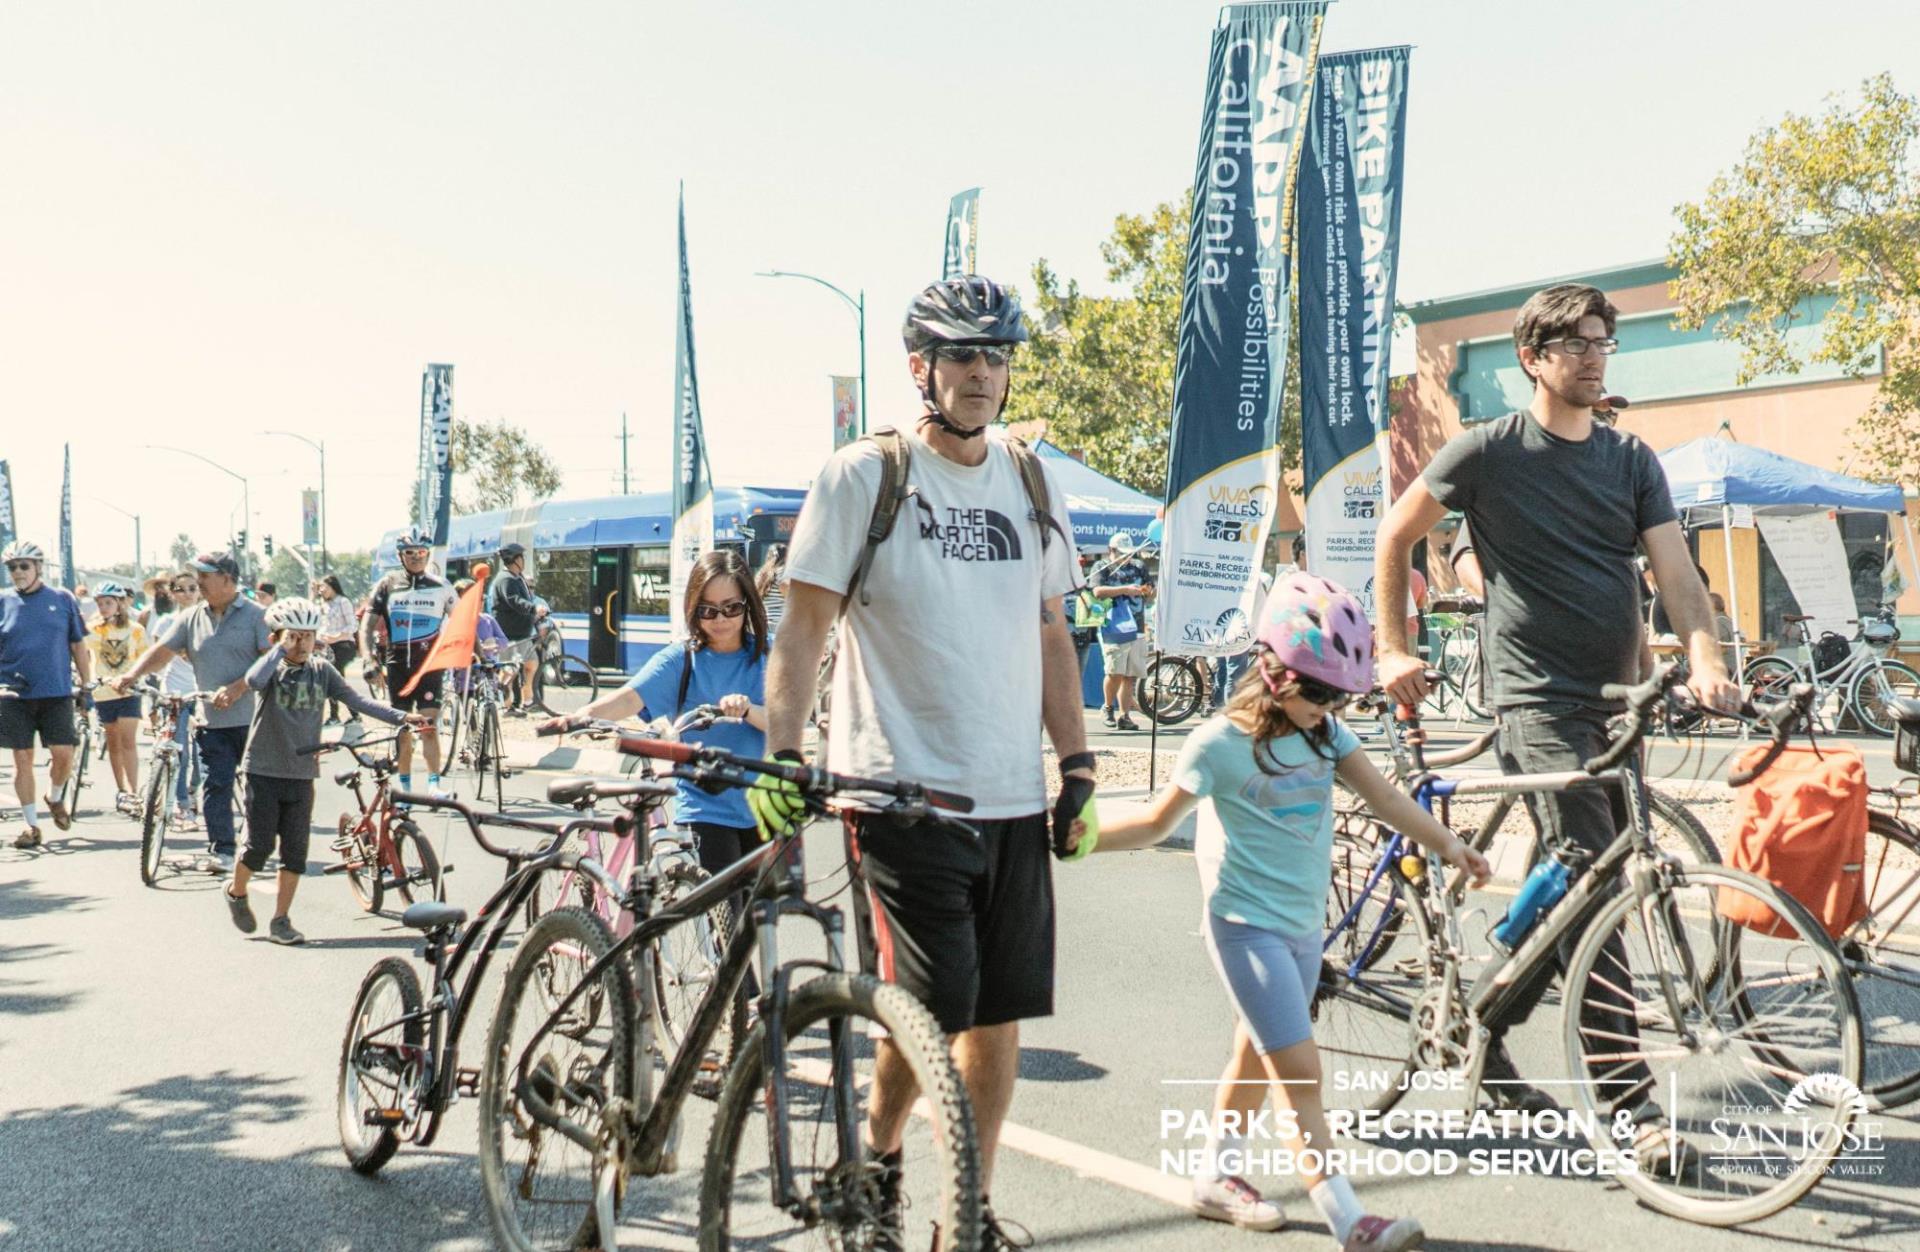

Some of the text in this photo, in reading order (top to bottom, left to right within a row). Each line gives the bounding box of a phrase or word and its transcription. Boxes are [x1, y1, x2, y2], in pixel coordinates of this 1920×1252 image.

[1323, 100, 1332, 117] not
[1356, 59, 1392, 179] BIKE
[1254, 15, 1303, 249] AARP
[1323, 118, 1332, 165] removed
[1202, 38, 1257, 286] California
[1322, 167, 1331, 196] when
[1333, 65, 1354, 427] Park at your own risk and provide your own lock.
[1325, 266, 1335, 295] ends,
[1262, 267, 1283, 328] Real
[1327, 296, 1336, 316] risk
[1326, 318, 1337, 353] having
[1328, 355, 1338, 381] their
[1328, 383, 1338, 405] lock
[432, 368, 450, 465] AARP
[1328, 406, 1338, 427] cut.
[1344, 471, 1377, 486] VIVA
[1209, 485, 1249, 503] VIVA
[947, 507, 985, 526] THE
[920, 521, 985, 543] NORTH
[1096, 523, 1118, 536] that
[942, 543, 987, 562] FACE
[1178, 568, 1241, 581] NEIGHBORHOOD
[1179, 558, 1213, 571] PARKS,
[1177, 579, 1204, 590] Building
[1204, 582, 1238, 592] Community
[1182, 623, 1218, 643] SAN
